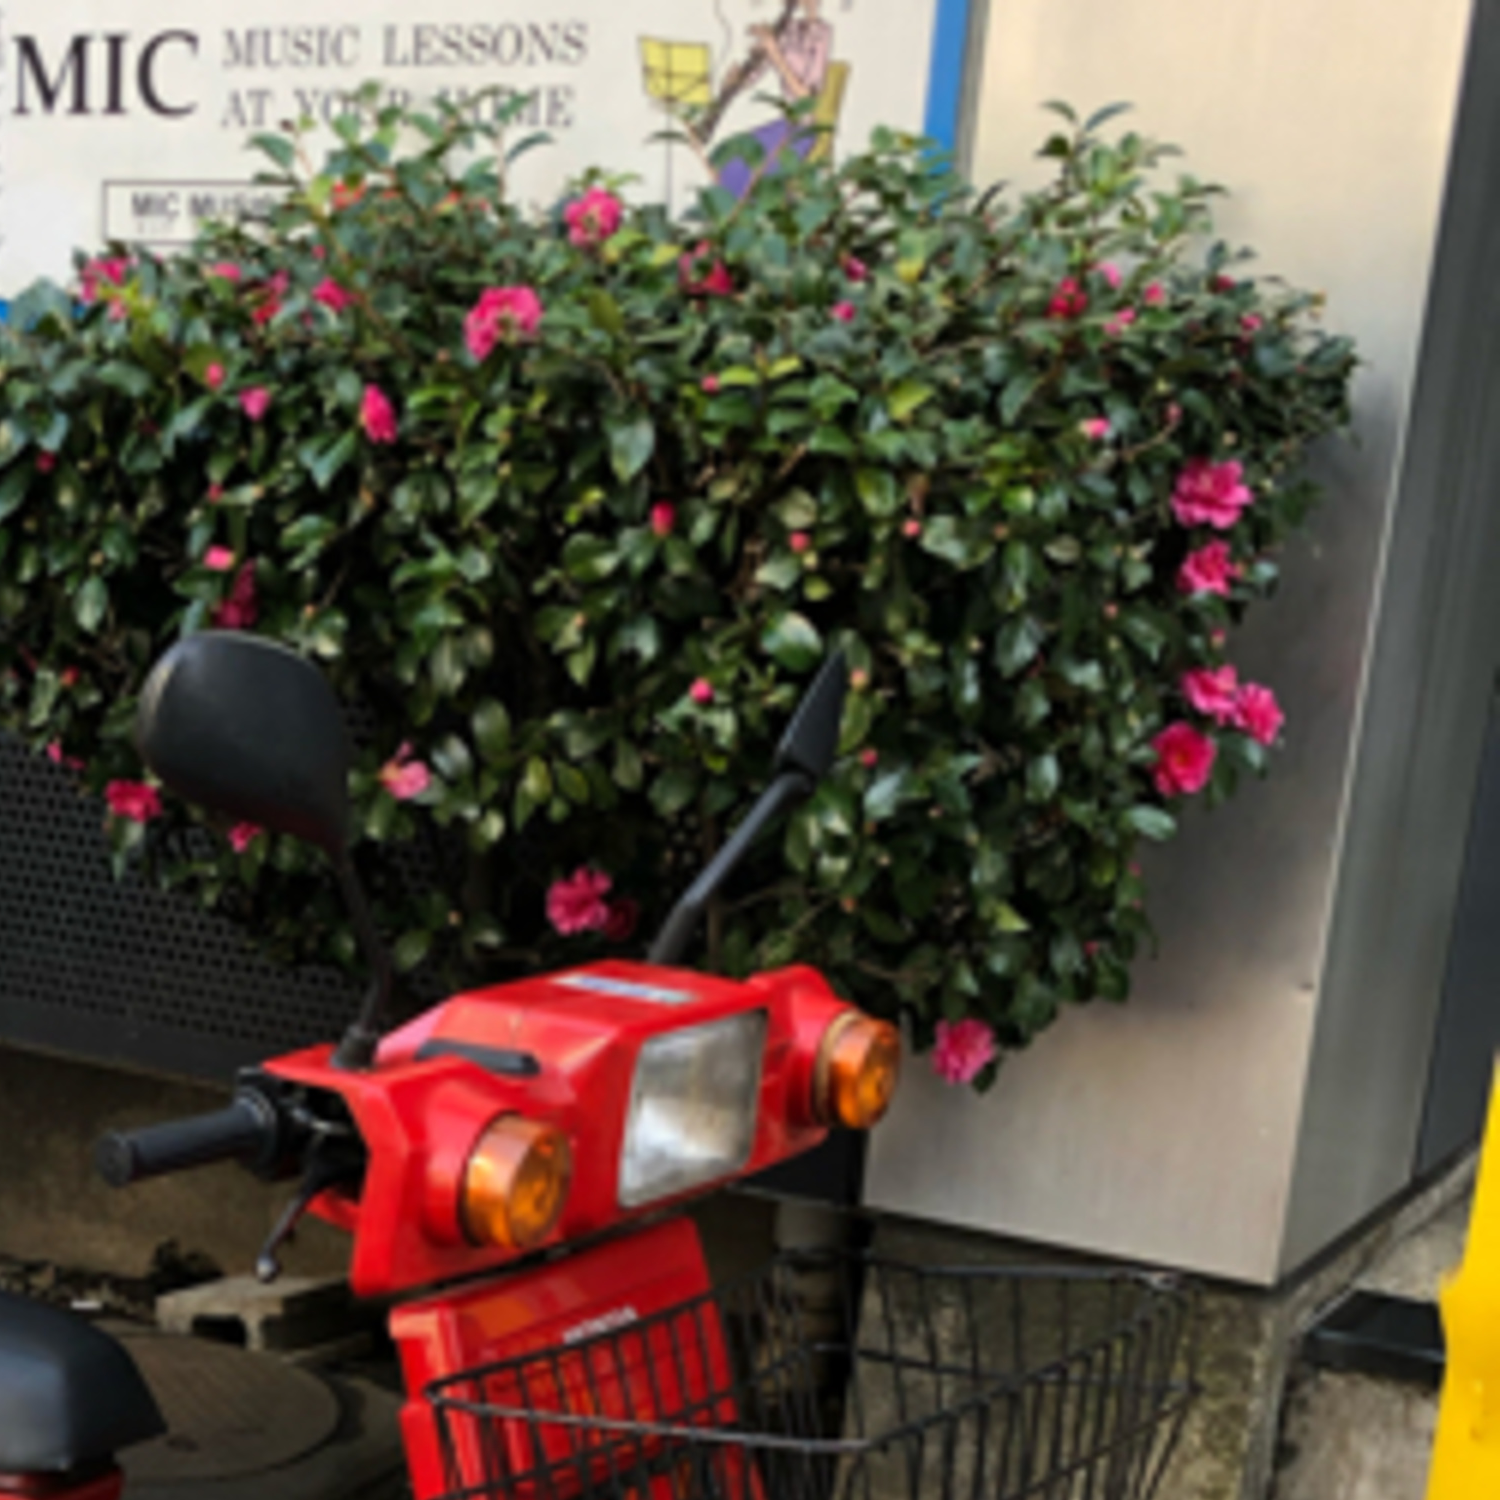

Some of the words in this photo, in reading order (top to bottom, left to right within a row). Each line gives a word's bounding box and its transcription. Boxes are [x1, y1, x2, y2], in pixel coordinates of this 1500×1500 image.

[221, 26, 361, 68] MUSIC
[382, 21, 589, 67] LESSONS
[11, 29, 200, 119] MIC
[221, 88, 273, 128] AT
[131, 192, 180, 219] MIC
